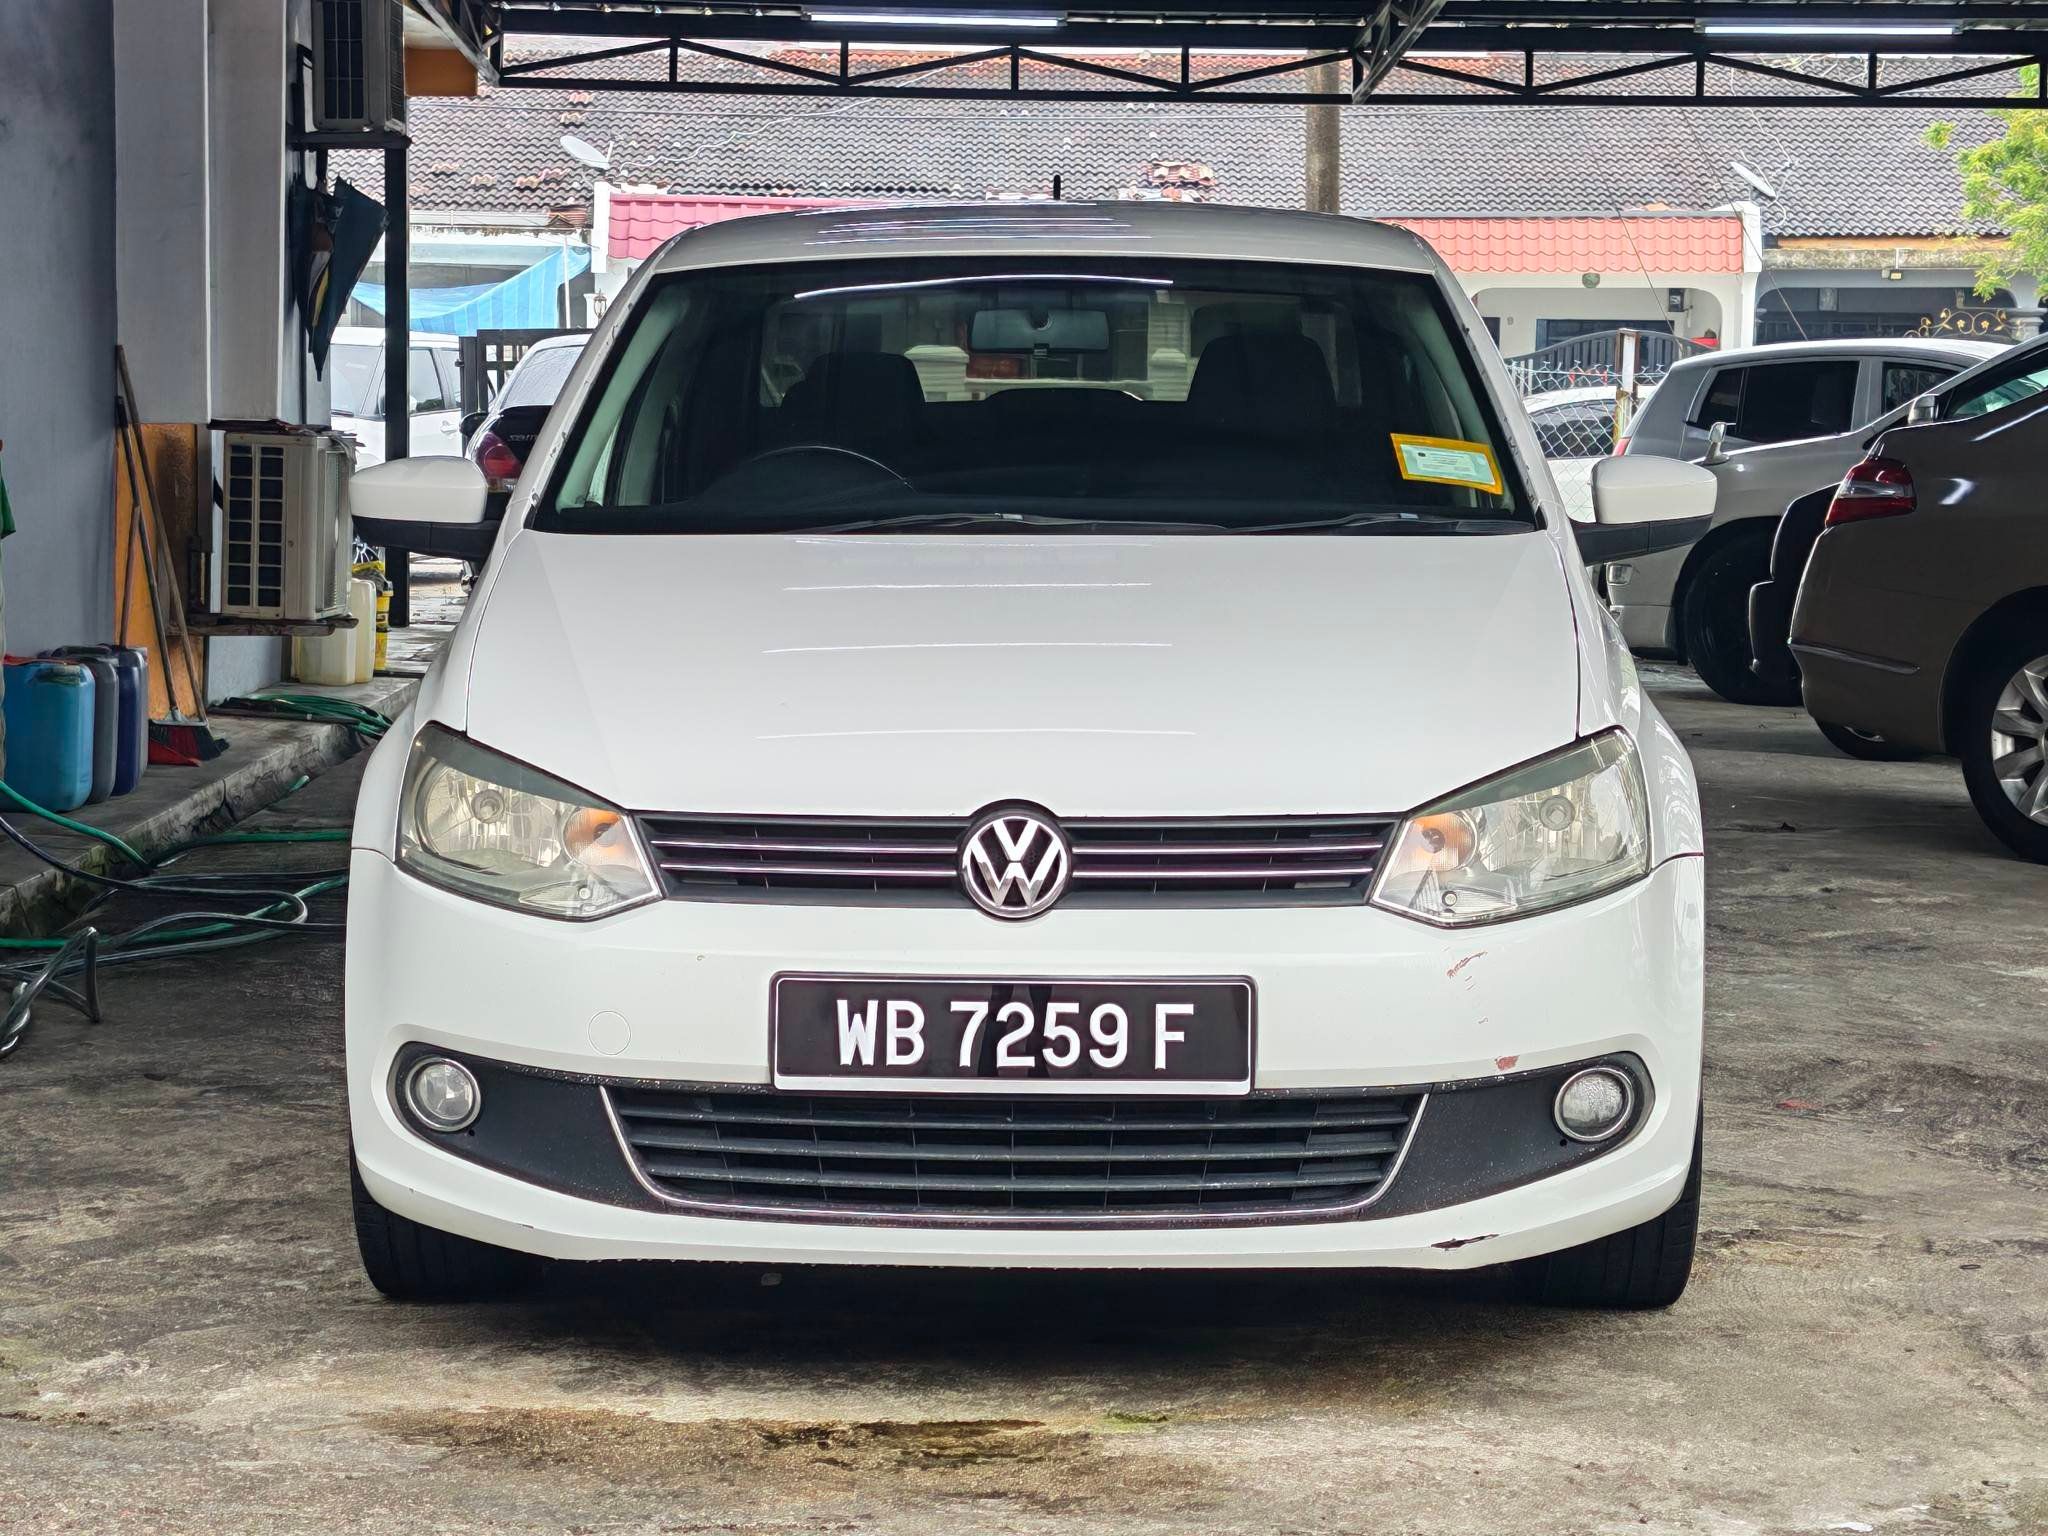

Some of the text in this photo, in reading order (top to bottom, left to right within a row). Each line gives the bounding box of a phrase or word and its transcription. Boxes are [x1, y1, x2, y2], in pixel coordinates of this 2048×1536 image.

[836, 999, 1195, 1070] WB 7259 F
